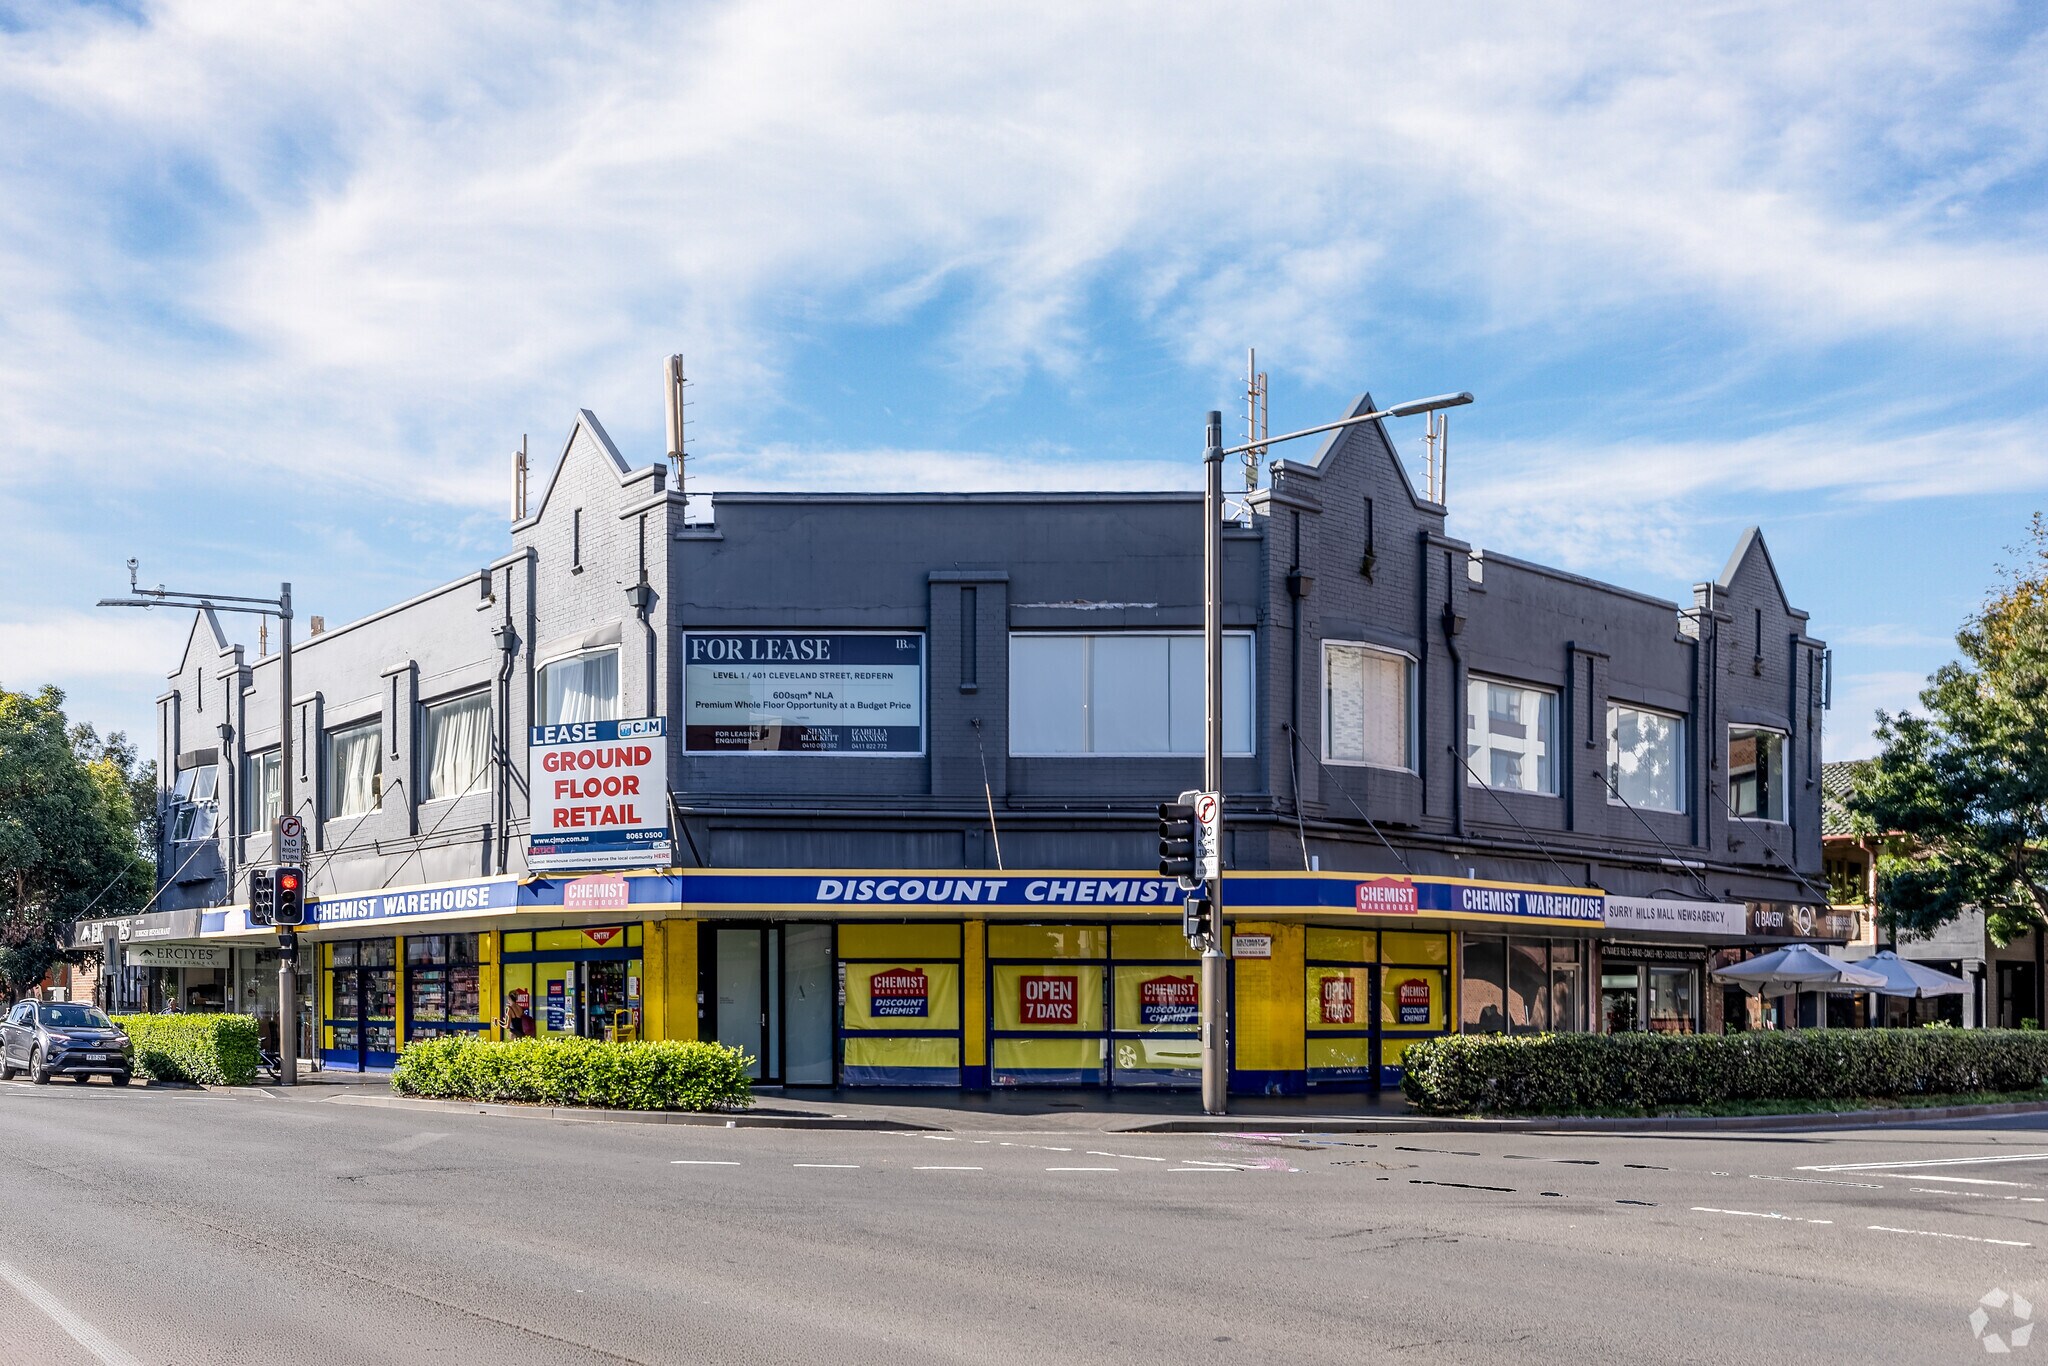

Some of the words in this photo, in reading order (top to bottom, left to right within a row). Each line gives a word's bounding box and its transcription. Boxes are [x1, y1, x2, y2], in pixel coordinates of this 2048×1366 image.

[692, 638, 744, 660] FOR
[750, 638, 830, 660] LEASE
[819, 672, 852, 681] STREET,
[786, 701, 838, 710] Opportunity
[857, 702, 887, 710] Budget
[532, 723, 597, 745] LEASE
[632, 721, 660, 733] CJM
[542, 746, 652, 773] GROUND
[554, 776, 640, 800] FLOOR
[553, 804, 642, 828] RETAIL
[1200, 826, 1212, 836] NO
[568, 883, 625, 899] CHEMIST
[816, 880, 1008, 901] DISCOUNT
[1024, 881, 1178, 902] CHEMIST
[1360, 886, 1414, 903] CHEMIST
[313, 898, 377, 921] CHEMIST
[383, 886, 490, 915] WAREHOUSE
[1361, 903, 1414, 911] WAREHOUSE
[1462, 889, 1520, 913] CHEMIST
[1525, 894, 1601, 918] WAREHOUSE
[1609, 906, 1633, 917] SURRY
[1636, 908, 1655, 919] HILLS
[1657, 908, 1674, 920] MALL
[1677, 909, 1725, 923] NEWSAGENCY
[1762, 912, 1784, 927] BAKERY
[594, 932, 609, 940] ENTRY
[157, 948, 213, 959] ERCIYES
[874, 976, 925, 988] CHEMIST
[1144, 983, 1195, 995] CHEMIST
[1026, 981, 1072, 1000] OPEN
[1325, 982, 1352, 1000] OPEN
[1401, 986, 1428, 997] CHEMIST
[1026, 1004, 1034, 1018] 7
[1037, 1004, 1072, 1018] DAYS
[1325, 1003, 1331, 1018] 7
[1331, 1003, 1351, 1018] DAYS
